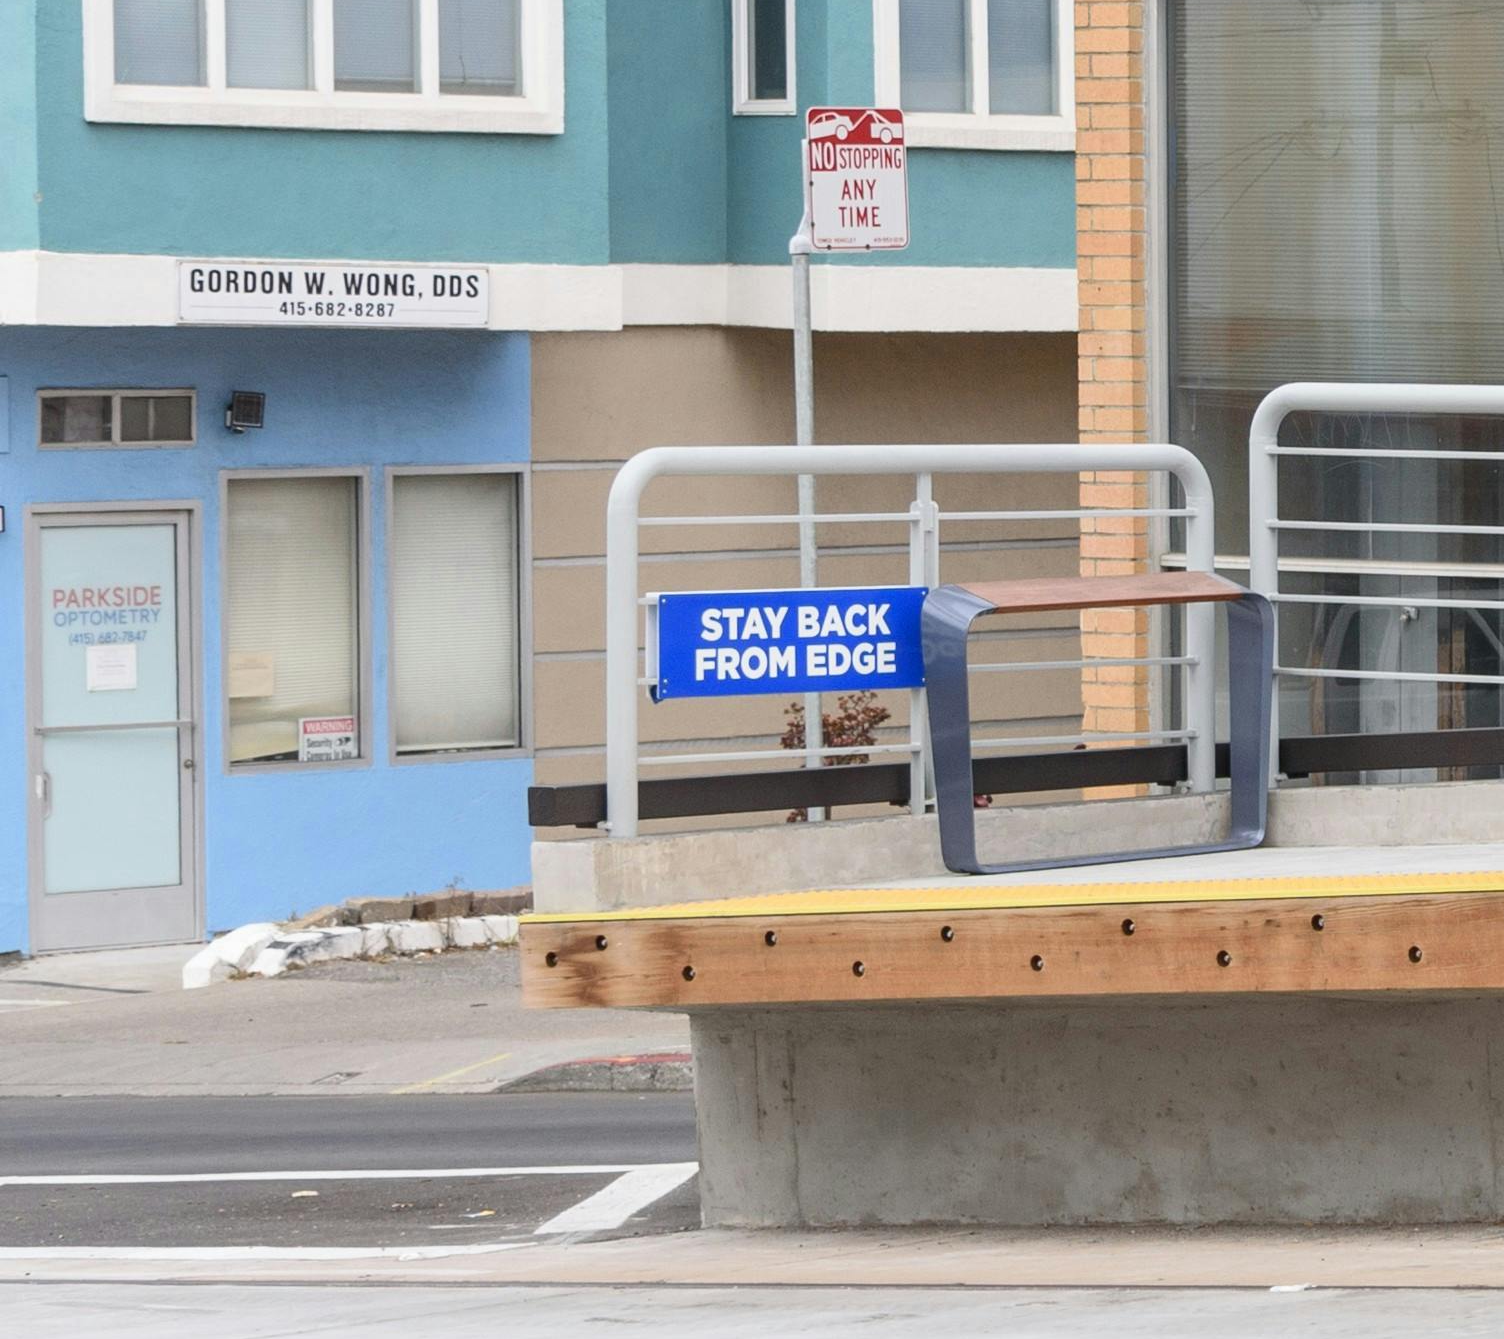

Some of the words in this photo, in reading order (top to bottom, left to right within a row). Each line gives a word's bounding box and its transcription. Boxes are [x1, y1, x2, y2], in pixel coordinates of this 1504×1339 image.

[811, 141, 836, 170] NO
[839, 147, 901, 170] STOPPING
[841, 178, 877, 200] ANY
[838, 206, 881, 228] TIME
[190, 268, 293, 294] GORDON
[304, 271, 333, 296] W.
[343, 272, 423, 300] WONG,
[432, 274, 480, 298] DDS
[53, 585, 162, 609] PARKSIDE
[54, 608, 161, 627] OPTOMETRY
[701, 606, 788, 641] STAY
[797, 603, 891, 638] BACK
[695, 645, 796, 681] FROM
[806, 642, 897, 677] EDGE
[304, 719, 353, 734] WARNING
